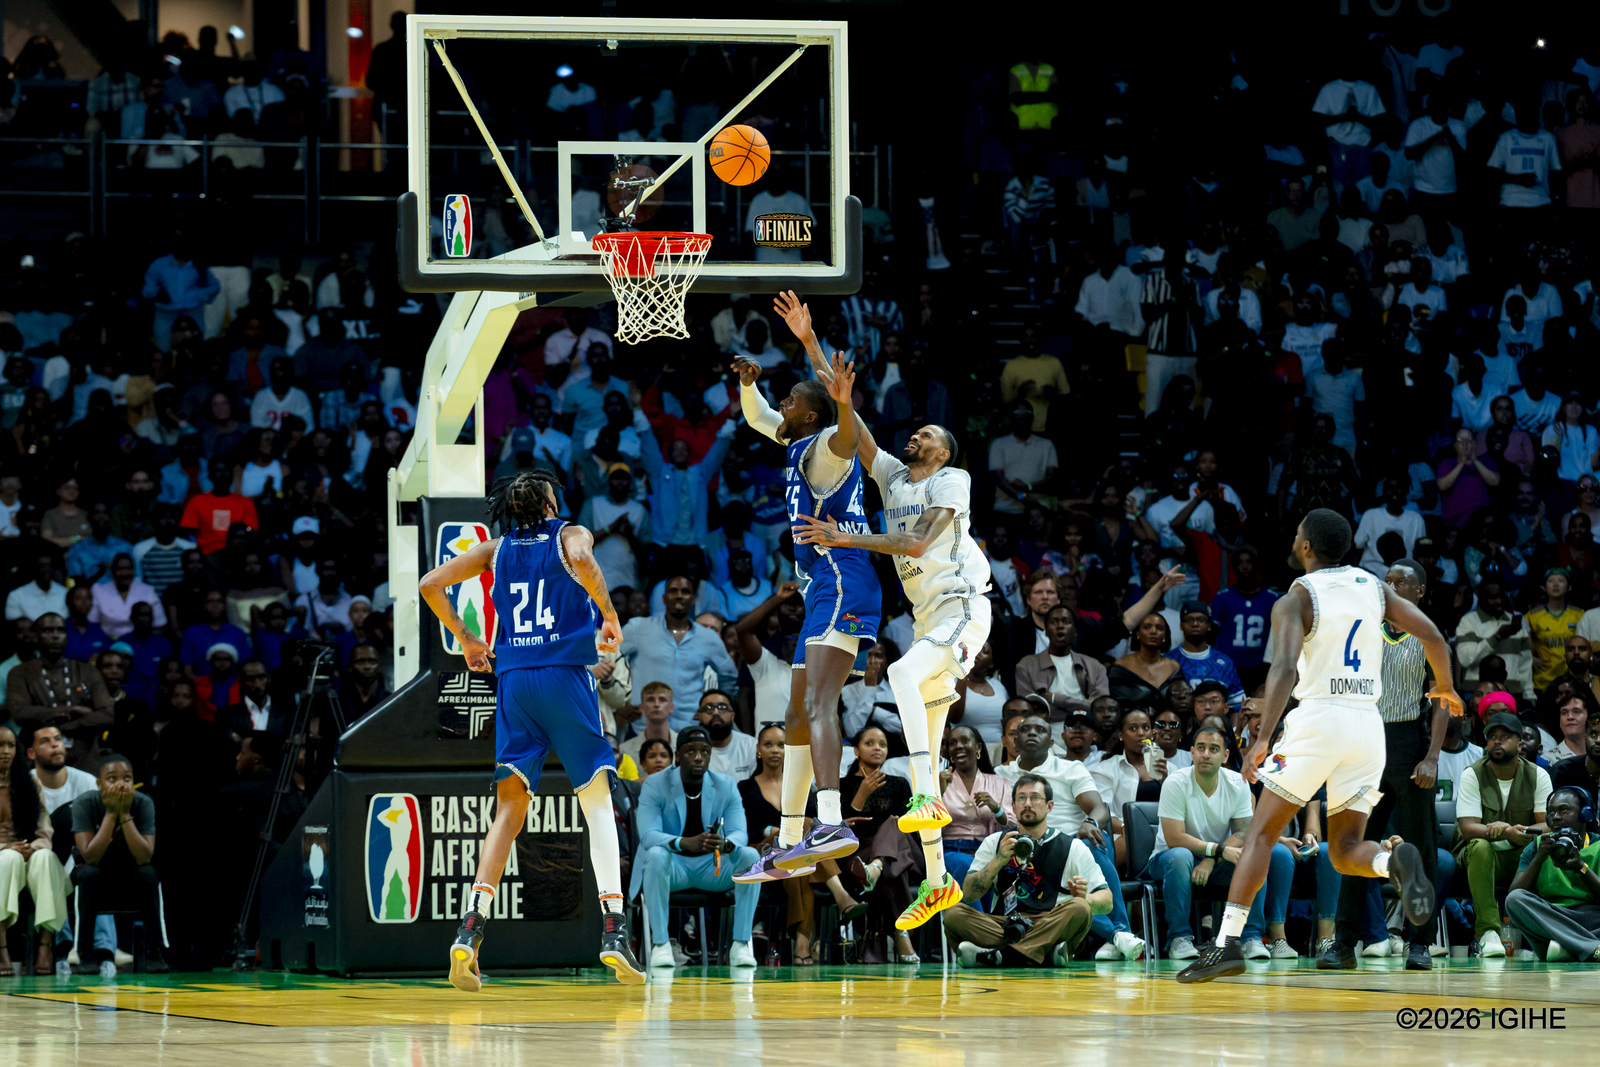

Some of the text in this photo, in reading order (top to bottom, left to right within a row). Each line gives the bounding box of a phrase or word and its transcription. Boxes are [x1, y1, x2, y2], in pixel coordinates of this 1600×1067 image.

[766, 220, 812, 242] FINALS
[510, 579, 555, 633] 24
[1232, 613, 1264, 648] 12
[1344, 619, 1363, 672] 4
[431, 796, 584, 833] BASKBALL
[431, 839, 519, 877] AFRA
[431, 882, 524, 920] LEAUE
